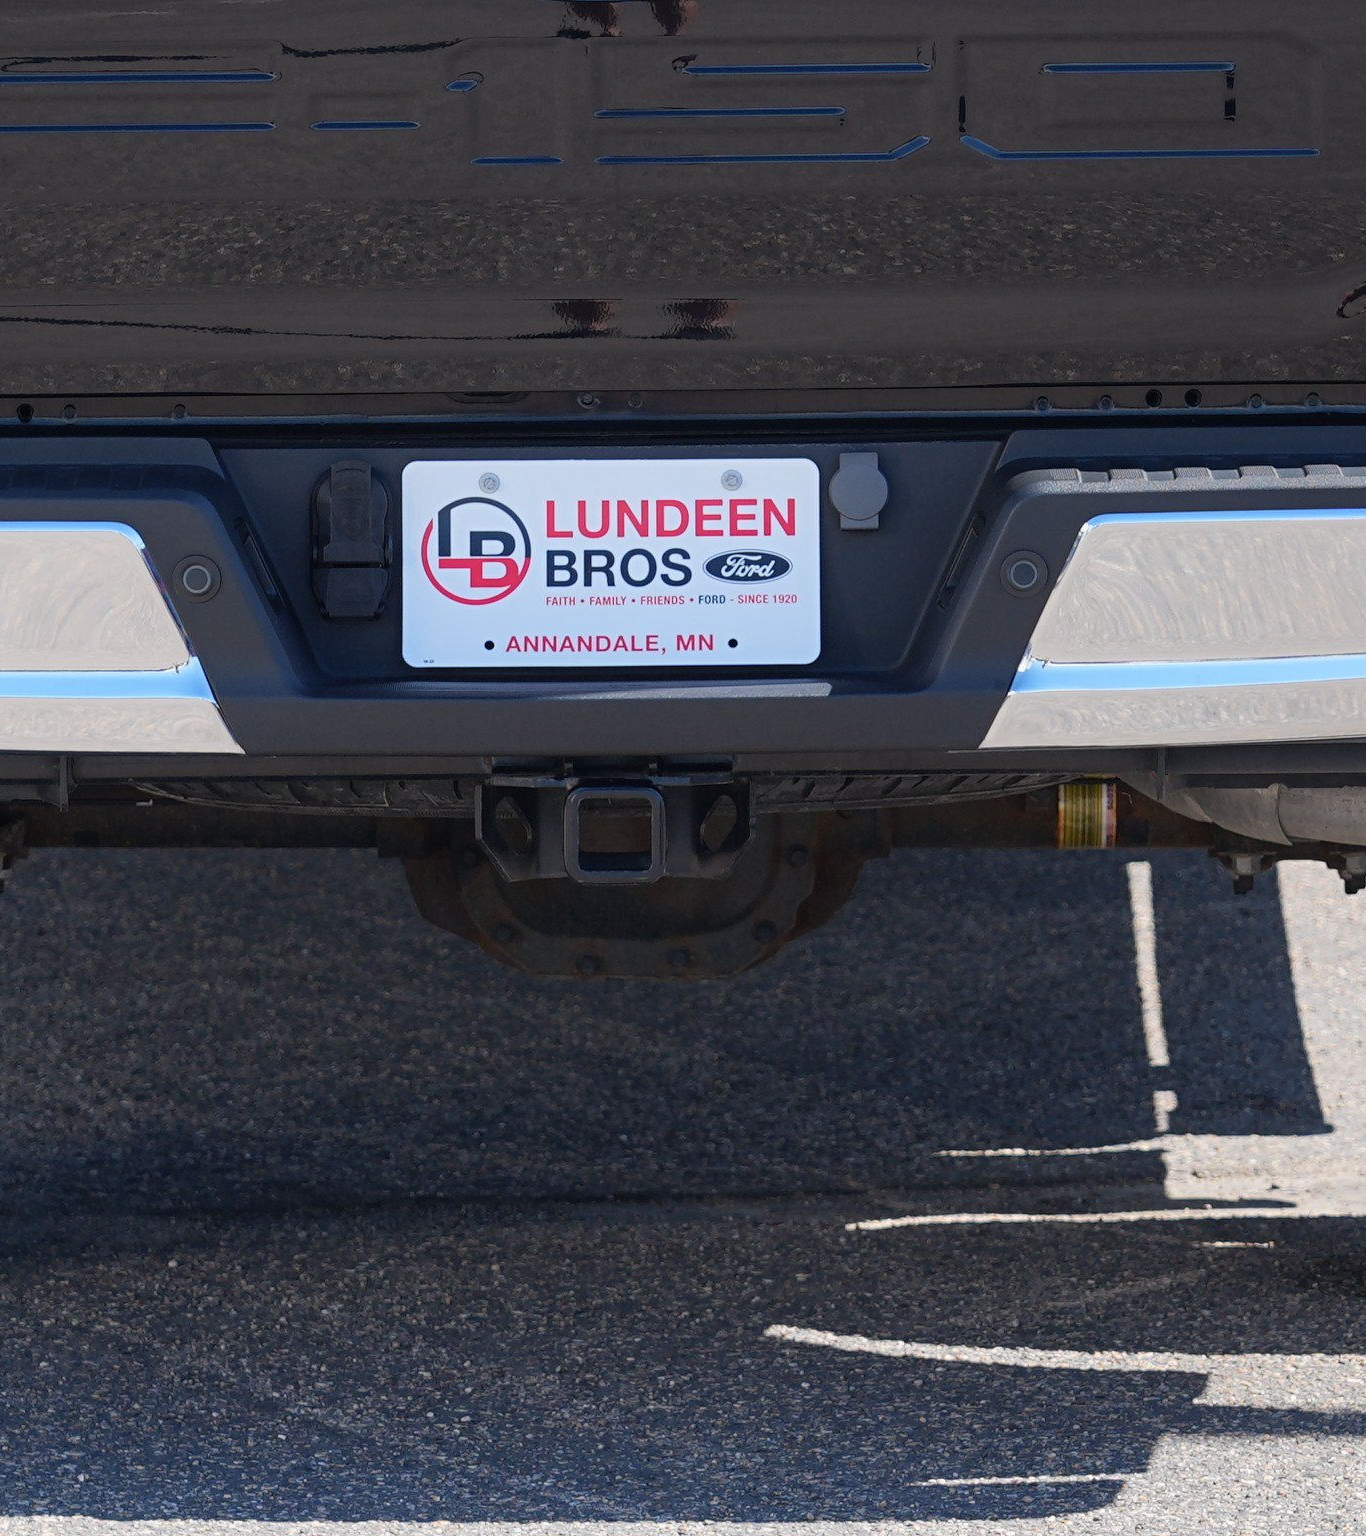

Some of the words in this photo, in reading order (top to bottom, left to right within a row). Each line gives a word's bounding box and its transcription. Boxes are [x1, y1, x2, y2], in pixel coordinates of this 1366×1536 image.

[545, 497, 797, 539] LUNDEEN
[545, 547, 693, 588] BROS
[720, 554, 776, 579] Ford
[545, 596, 576, 606] FAITH
[589, 596, 627, 606] FAMILY
[640, 595, 685, 606] FRIENDS
[698, 594, 726, 605] FORD
[737, 594, 769, 605] SINCE
[772, 594, 798, 604] 1920
[505, 633, 667, 655] ANNANDALE,
[676, 633, 715, 652] MN
